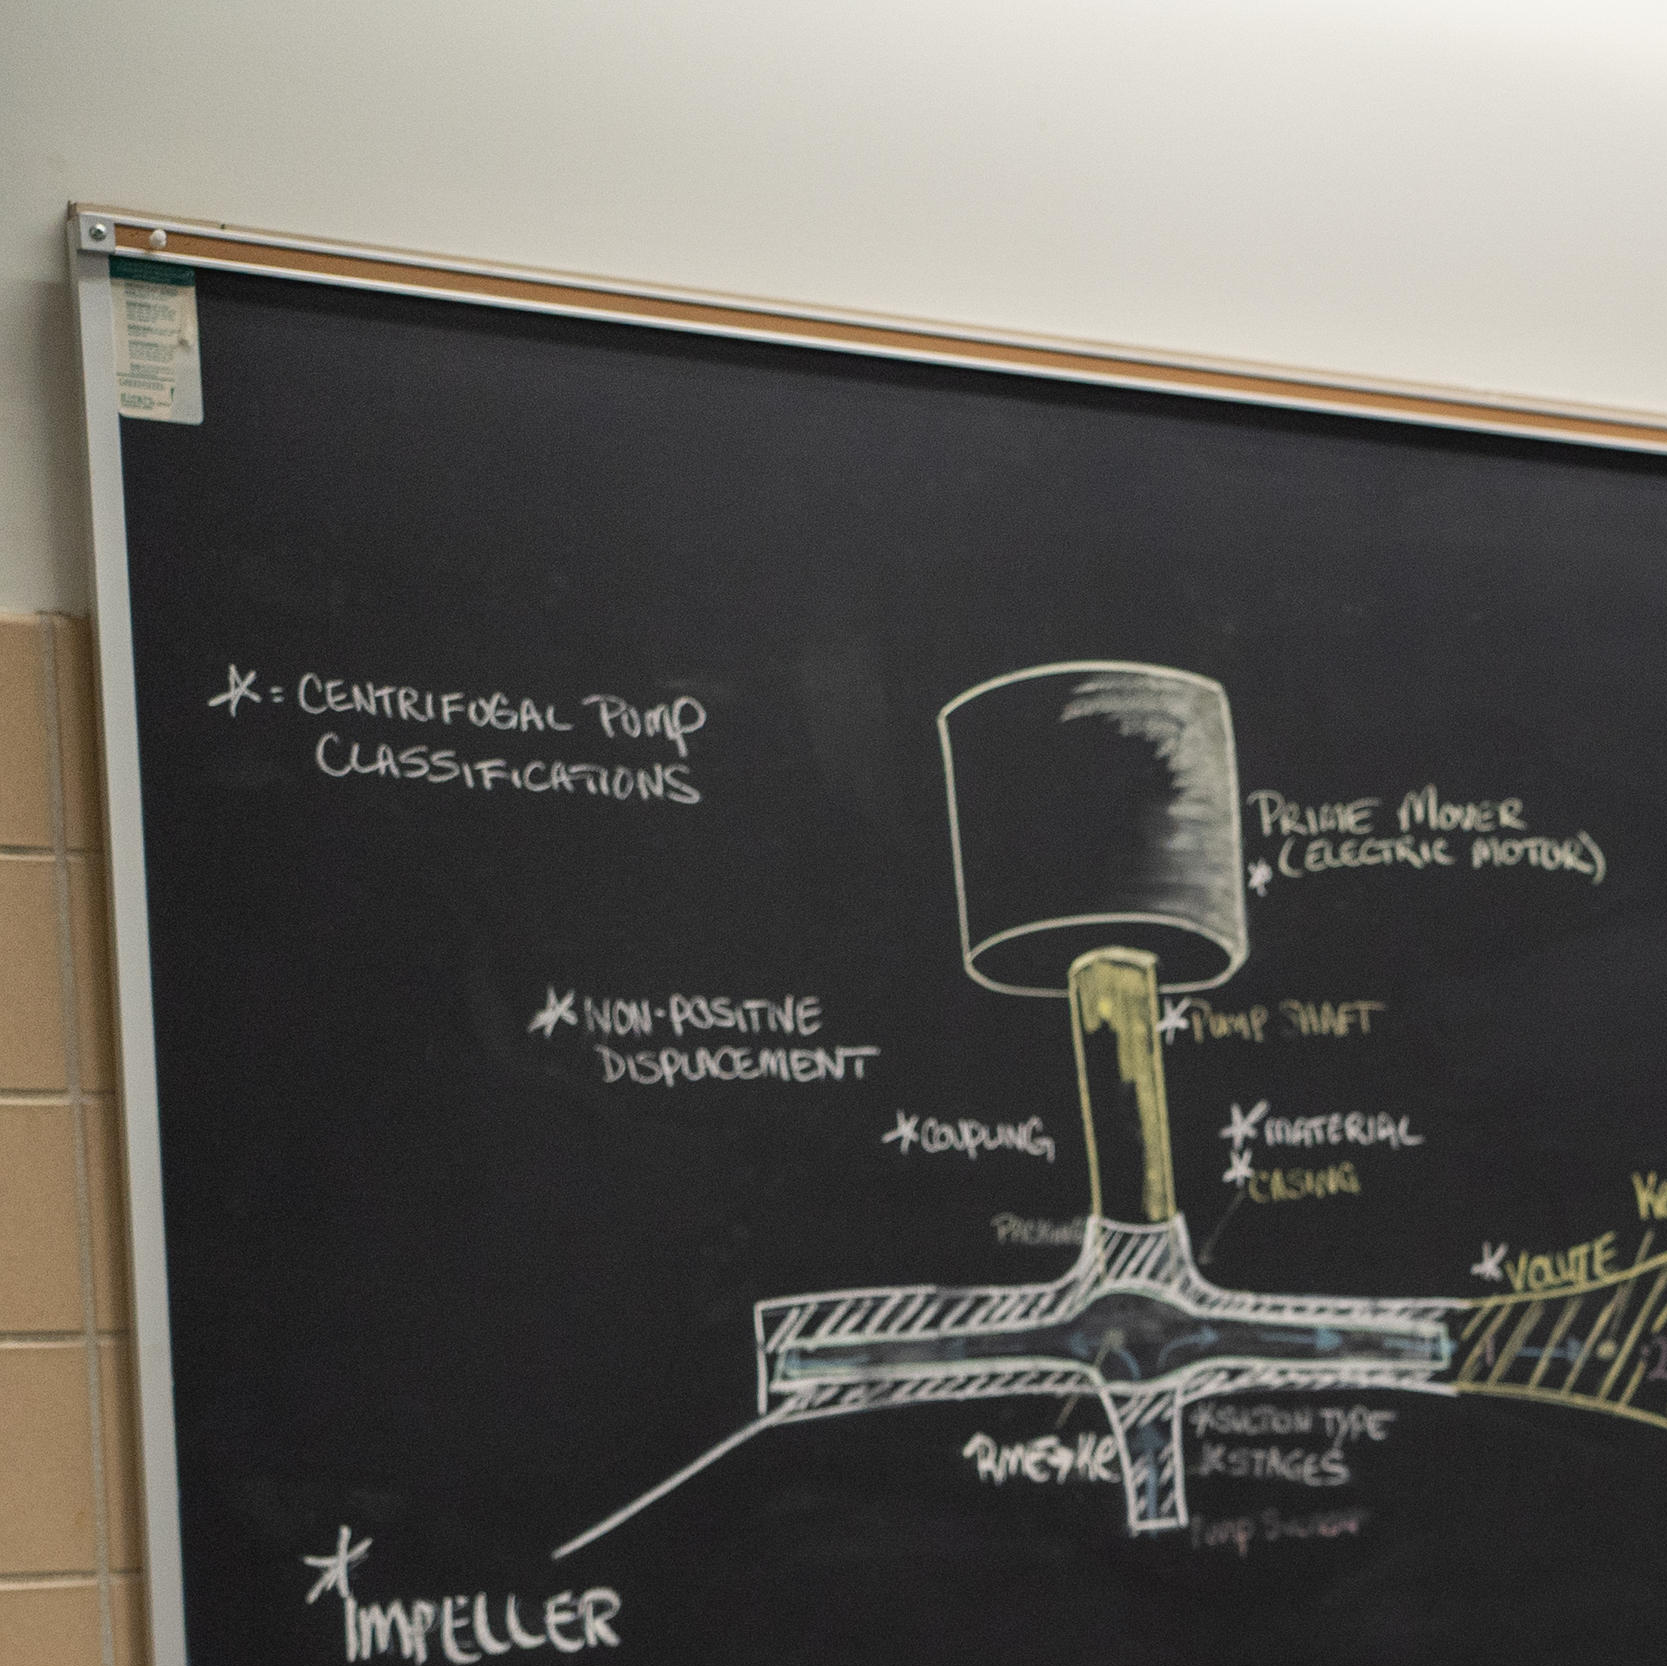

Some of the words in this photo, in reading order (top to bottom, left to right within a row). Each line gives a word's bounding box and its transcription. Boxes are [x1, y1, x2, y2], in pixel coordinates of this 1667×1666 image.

[316, 732, 701, 804] CLASSIFICATIONS
[1247, 789, 1381, 836] PRIME
[1397, 782, 1527, 834] MOVER
[1265, 1109, 1425, 1149] MATERIAL
[344, 1586, 622, 1666] IMPELLER
